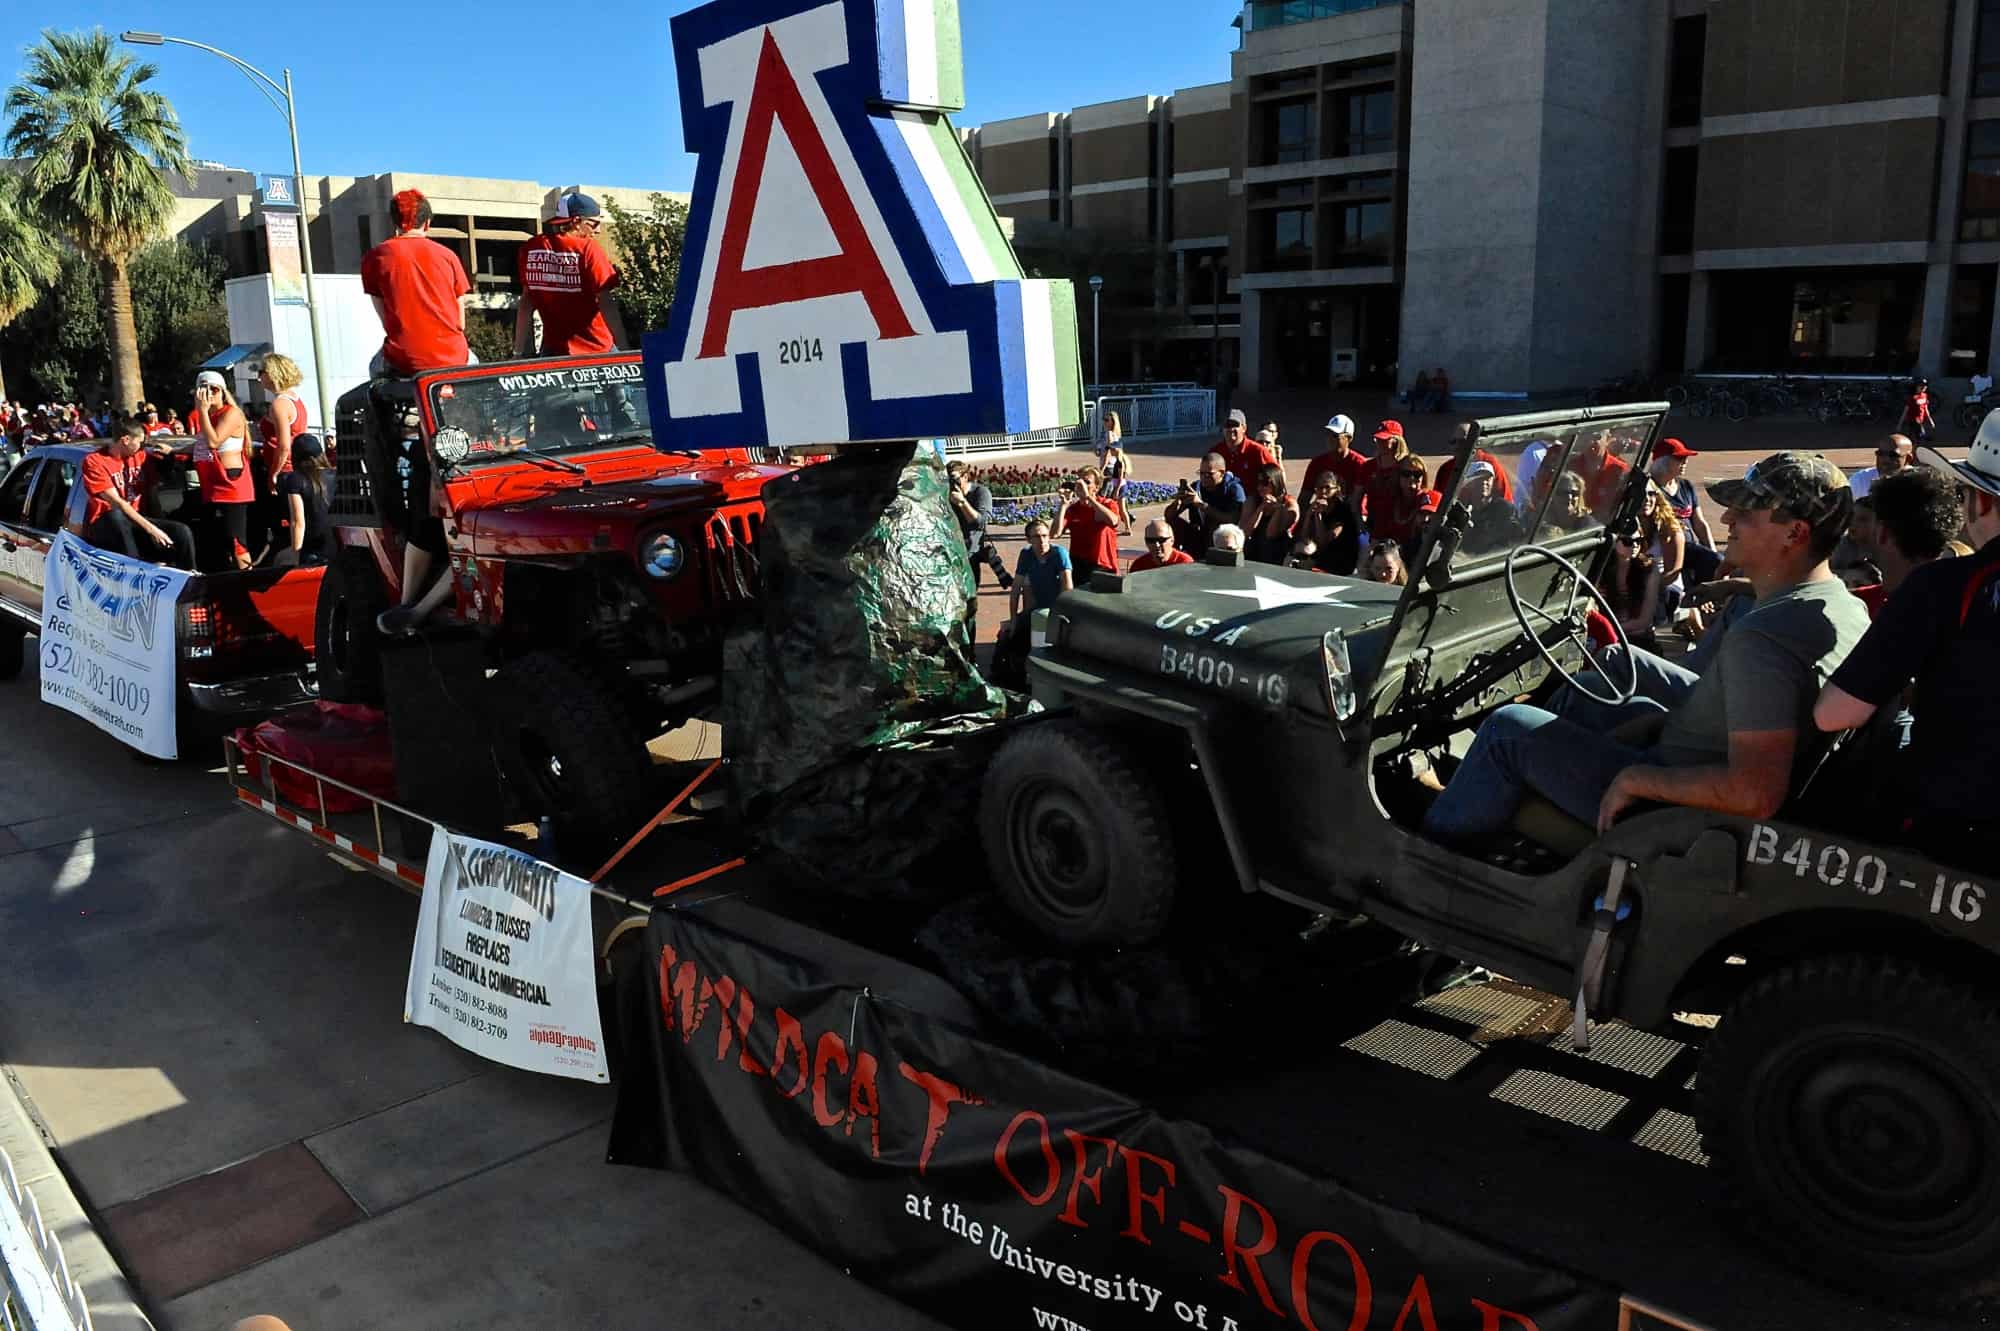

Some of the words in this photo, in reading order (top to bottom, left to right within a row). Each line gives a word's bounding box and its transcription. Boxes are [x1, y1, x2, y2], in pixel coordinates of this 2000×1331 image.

[498, 371, 569, 391] WILDCAT
[572, 365, 641, 382] OFF-ROAD
[779, 338, 823, 364] 2014
[86, 658, 150, 716] 382-1009
[1160, 644, 1288, 704] B400-16
[467, 848, 560, 922] COMPONENTS
[1746, 823, 1986, 922] B400-16
[495, 911, 531, 941] TRUSSES
[488, 968, 552, 1006] COMMERCIAL
[528, 1027, 597, 1054] alphagraphics
[659, 943, 986, 1175] WILDCAT
[904, 1193, 931, 1221] at
[942, 1203, 984, 1245] the
[990, 1224, 1162, 1312] University
[1173, 1300, 1208, 1331] of
